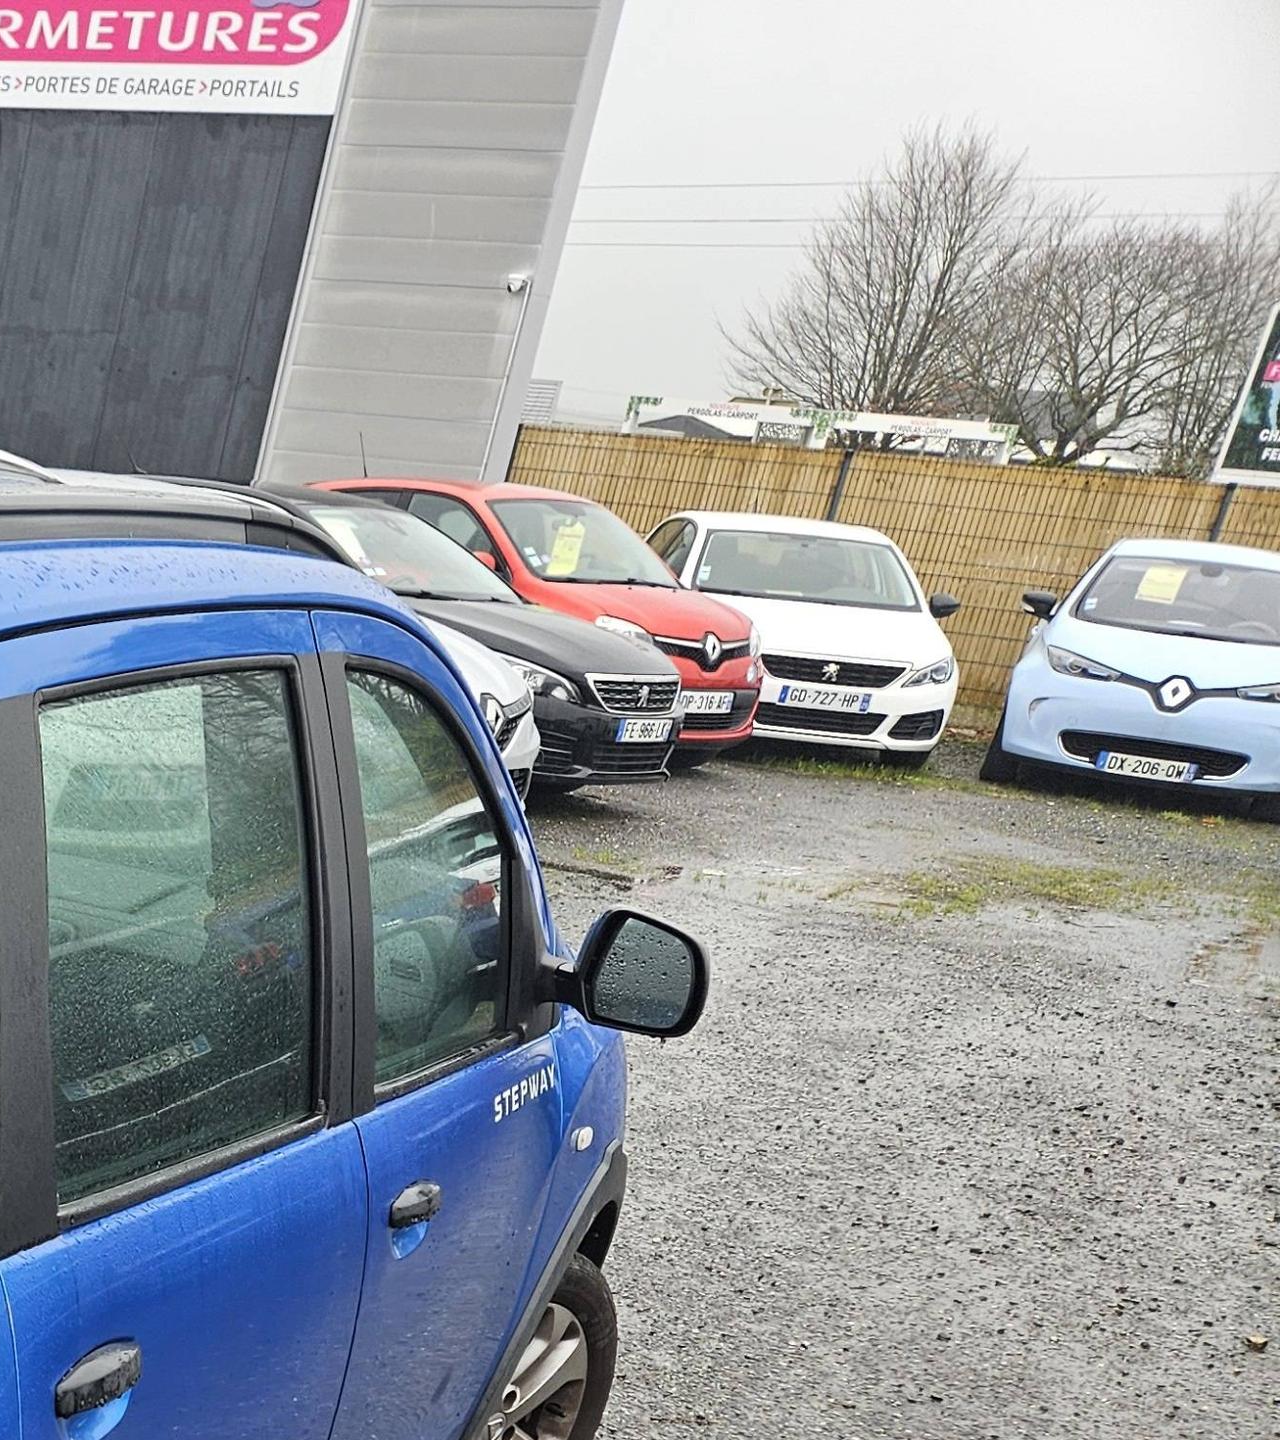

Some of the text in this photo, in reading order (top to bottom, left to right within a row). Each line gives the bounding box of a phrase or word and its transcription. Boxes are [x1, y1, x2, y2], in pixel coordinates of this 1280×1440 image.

[95, 77, 120, 94] DE
[789, 687, 860, 708] GD-727-HP
[494, 1063, 555, 1123] STEPWAY
